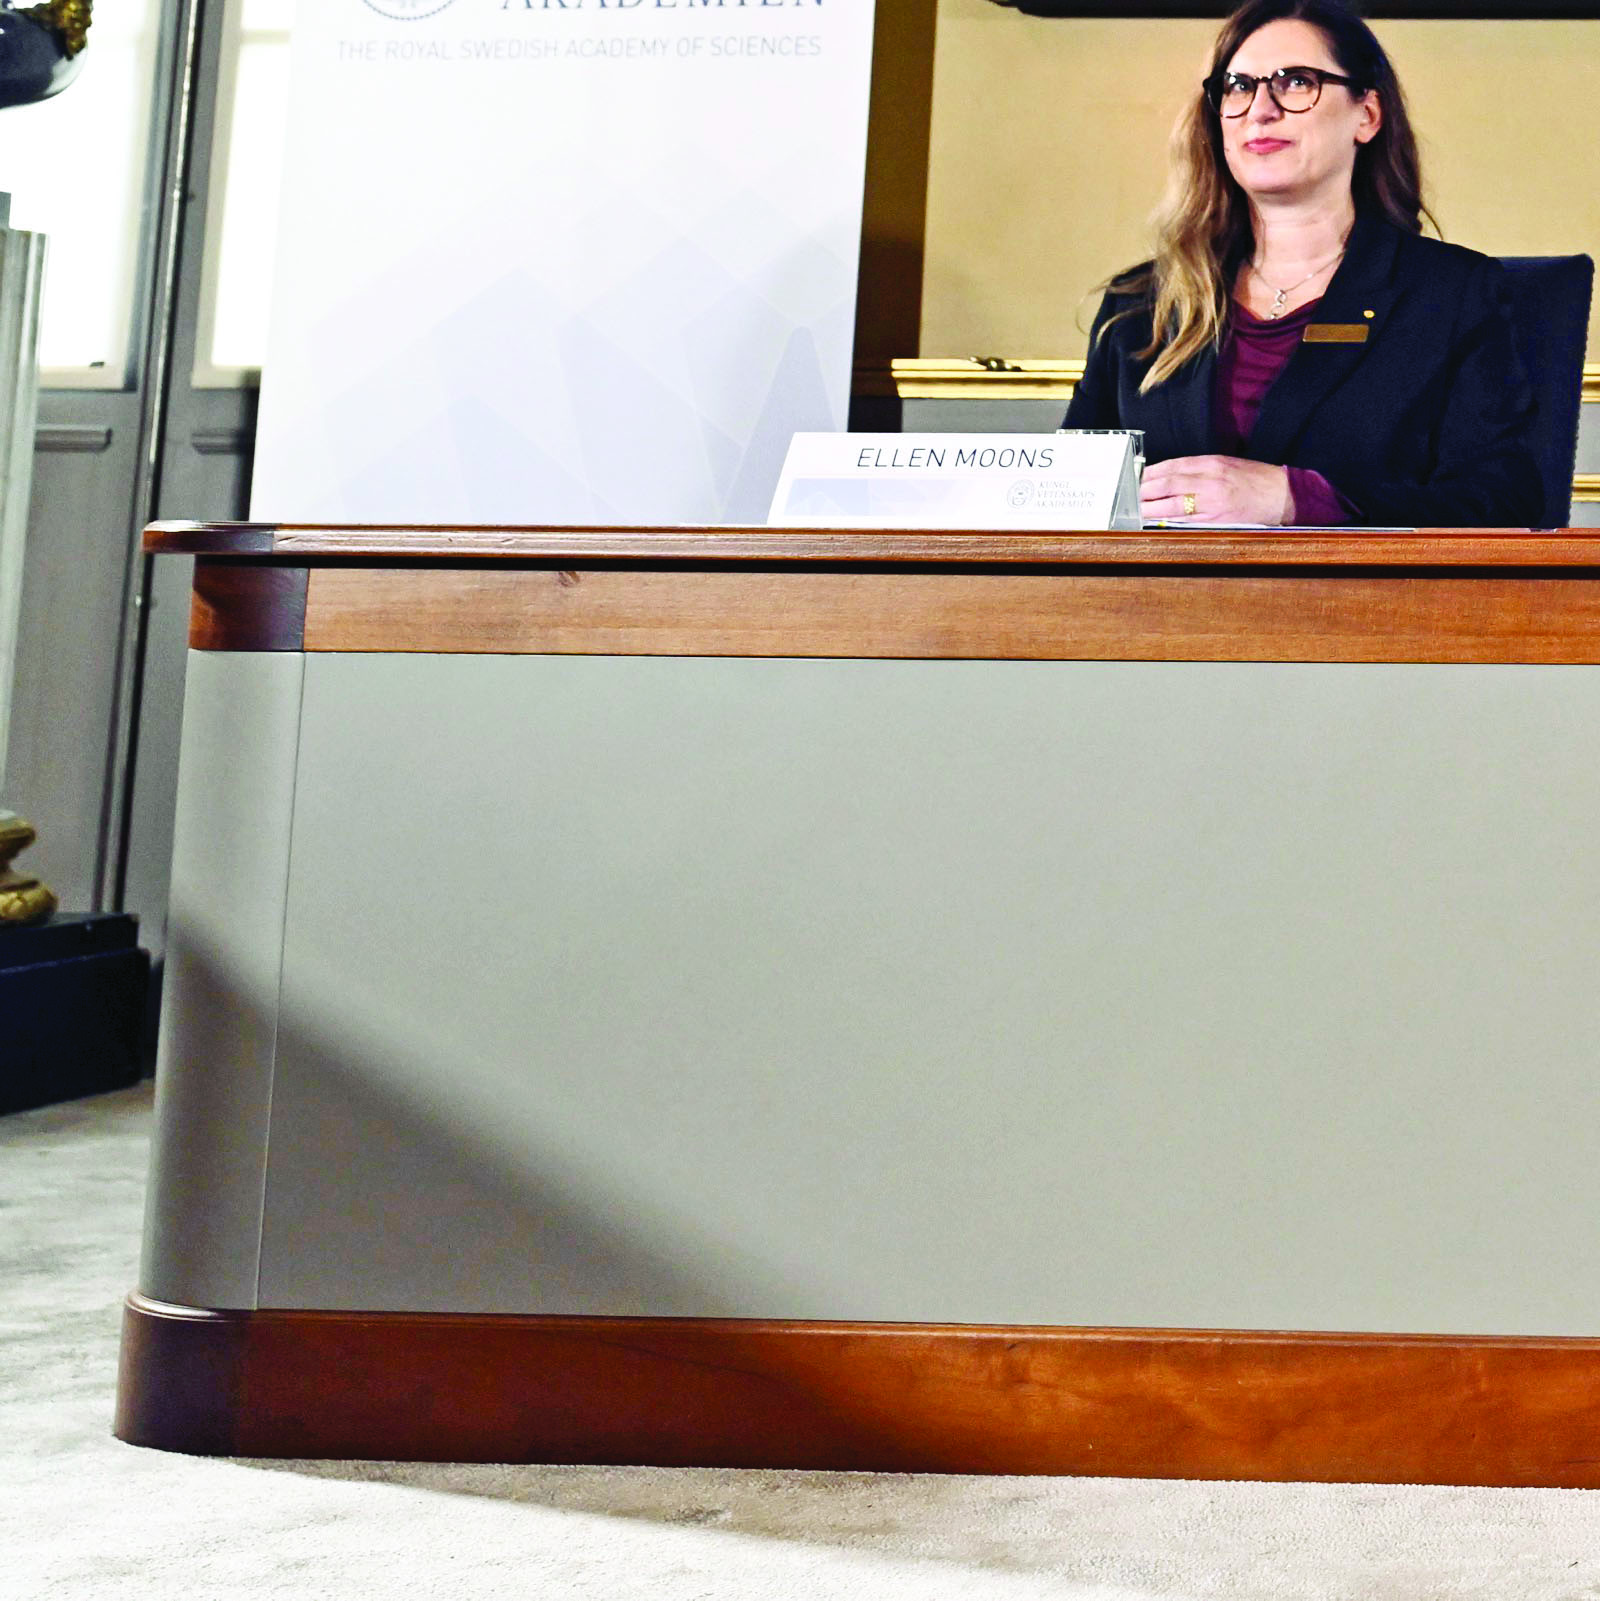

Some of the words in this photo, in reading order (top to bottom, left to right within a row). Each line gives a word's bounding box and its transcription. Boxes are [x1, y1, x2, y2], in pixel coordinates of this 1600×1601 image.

[339, 40, 376, 60] THE
[385, 40, 451, 60] ROYAL
[461, 39, 558, 59] SWEDISH
[566, 38, 667, 57] ACADEMY
[677, 37, 704, 57] OF
[711, 36, 821, 56] SCIENCES
[857, 448, 945, 467] ELLEN
[955, 449, 1053, 467] MOONS
